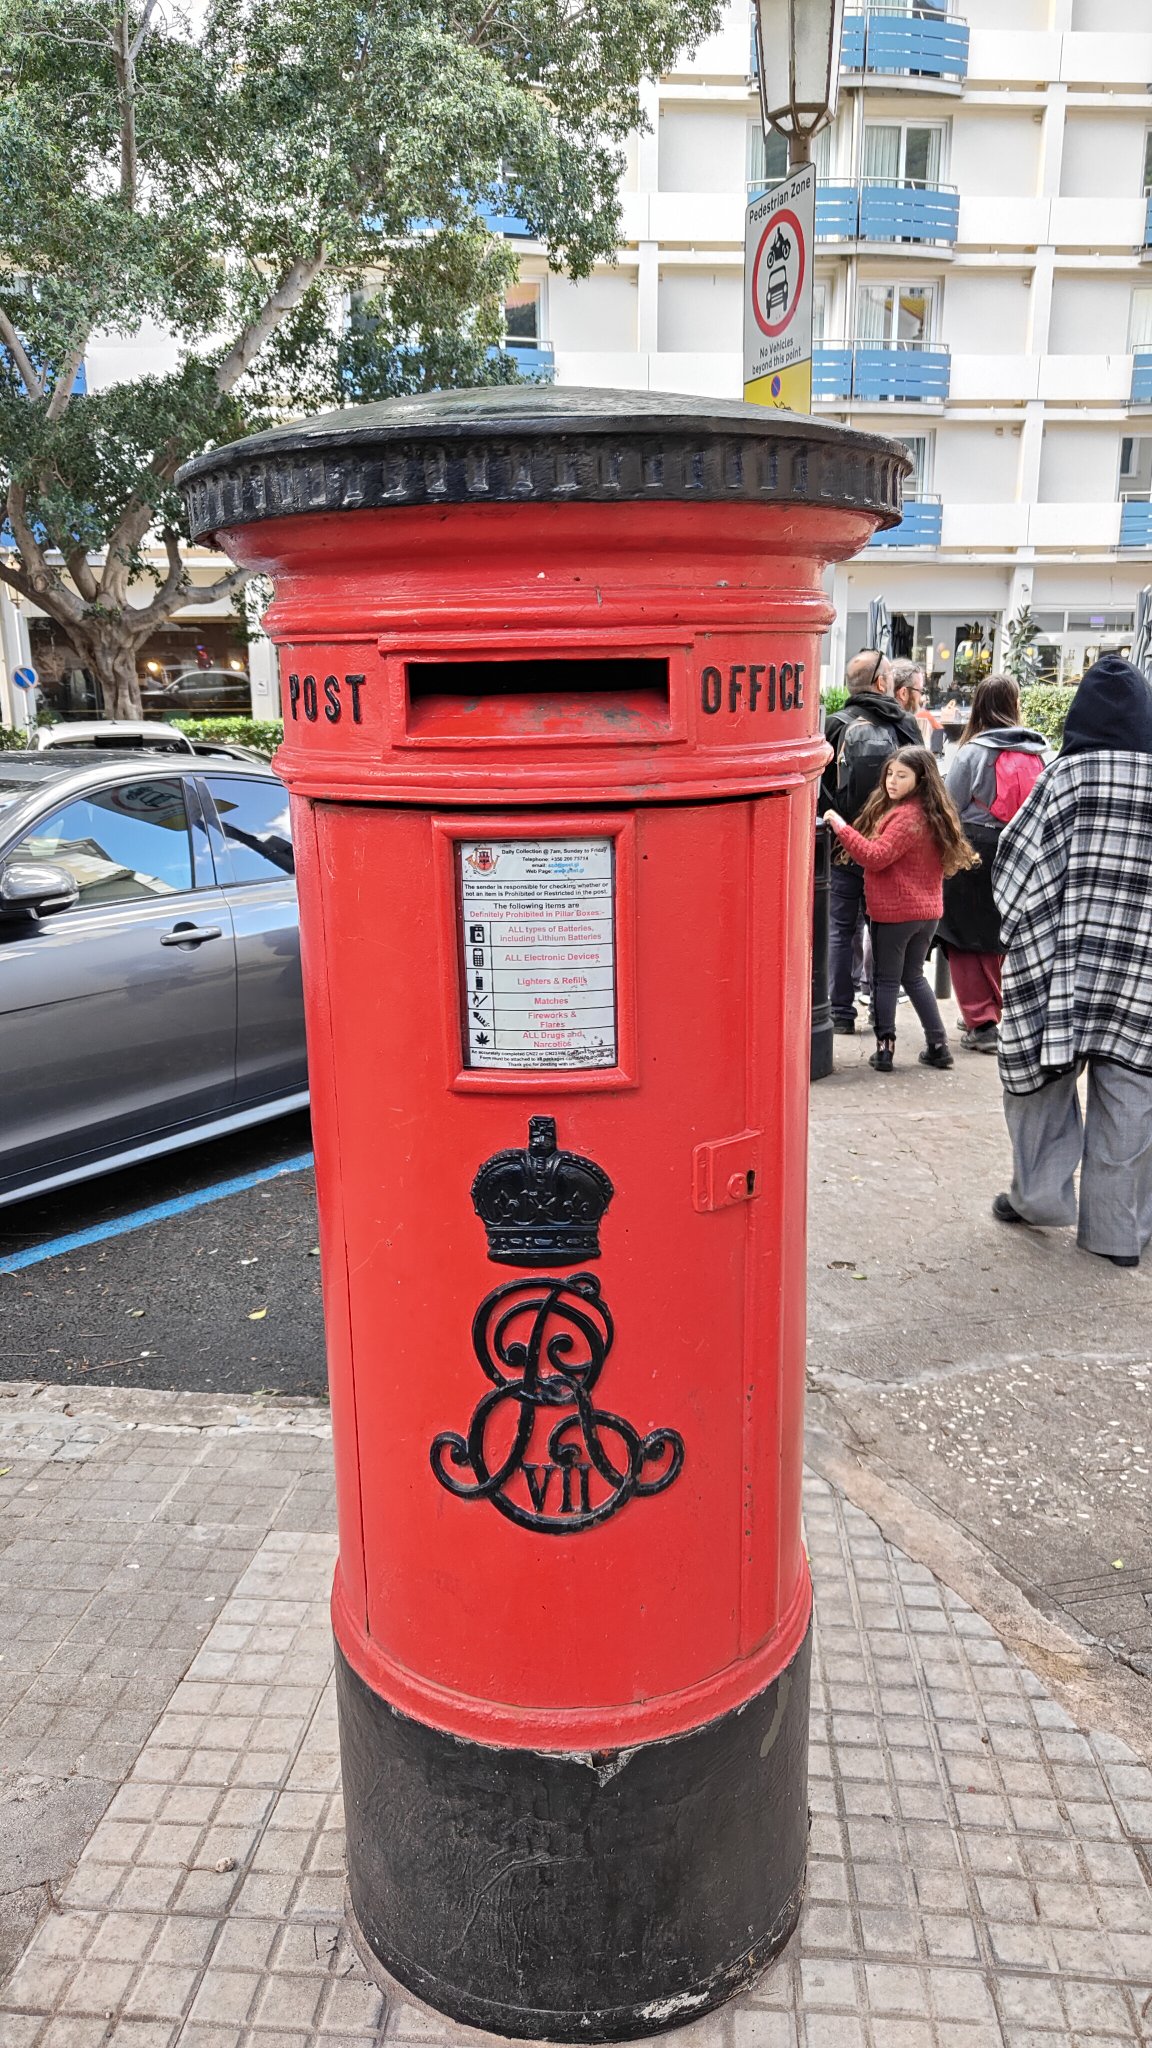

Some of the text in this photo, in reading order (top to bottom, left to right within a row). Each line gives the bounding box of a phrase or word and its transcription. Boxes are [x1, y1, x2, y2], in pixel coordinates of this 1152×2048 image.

[750, 177, 810, 224] Pedestrian Zone
[760, 338, 793, 358] No Vehicles
[752, 346, 801, 375] beyond this point
[288, 662, 804, 724] POST OFFICE
[526, 926, 546, 935] types
[500, 935, 536, 943] including
[518, 977, 551, 986] Lighters
[562, 976, 587, 985] Refills
[541, 1032, 565, 1040] Drugs
